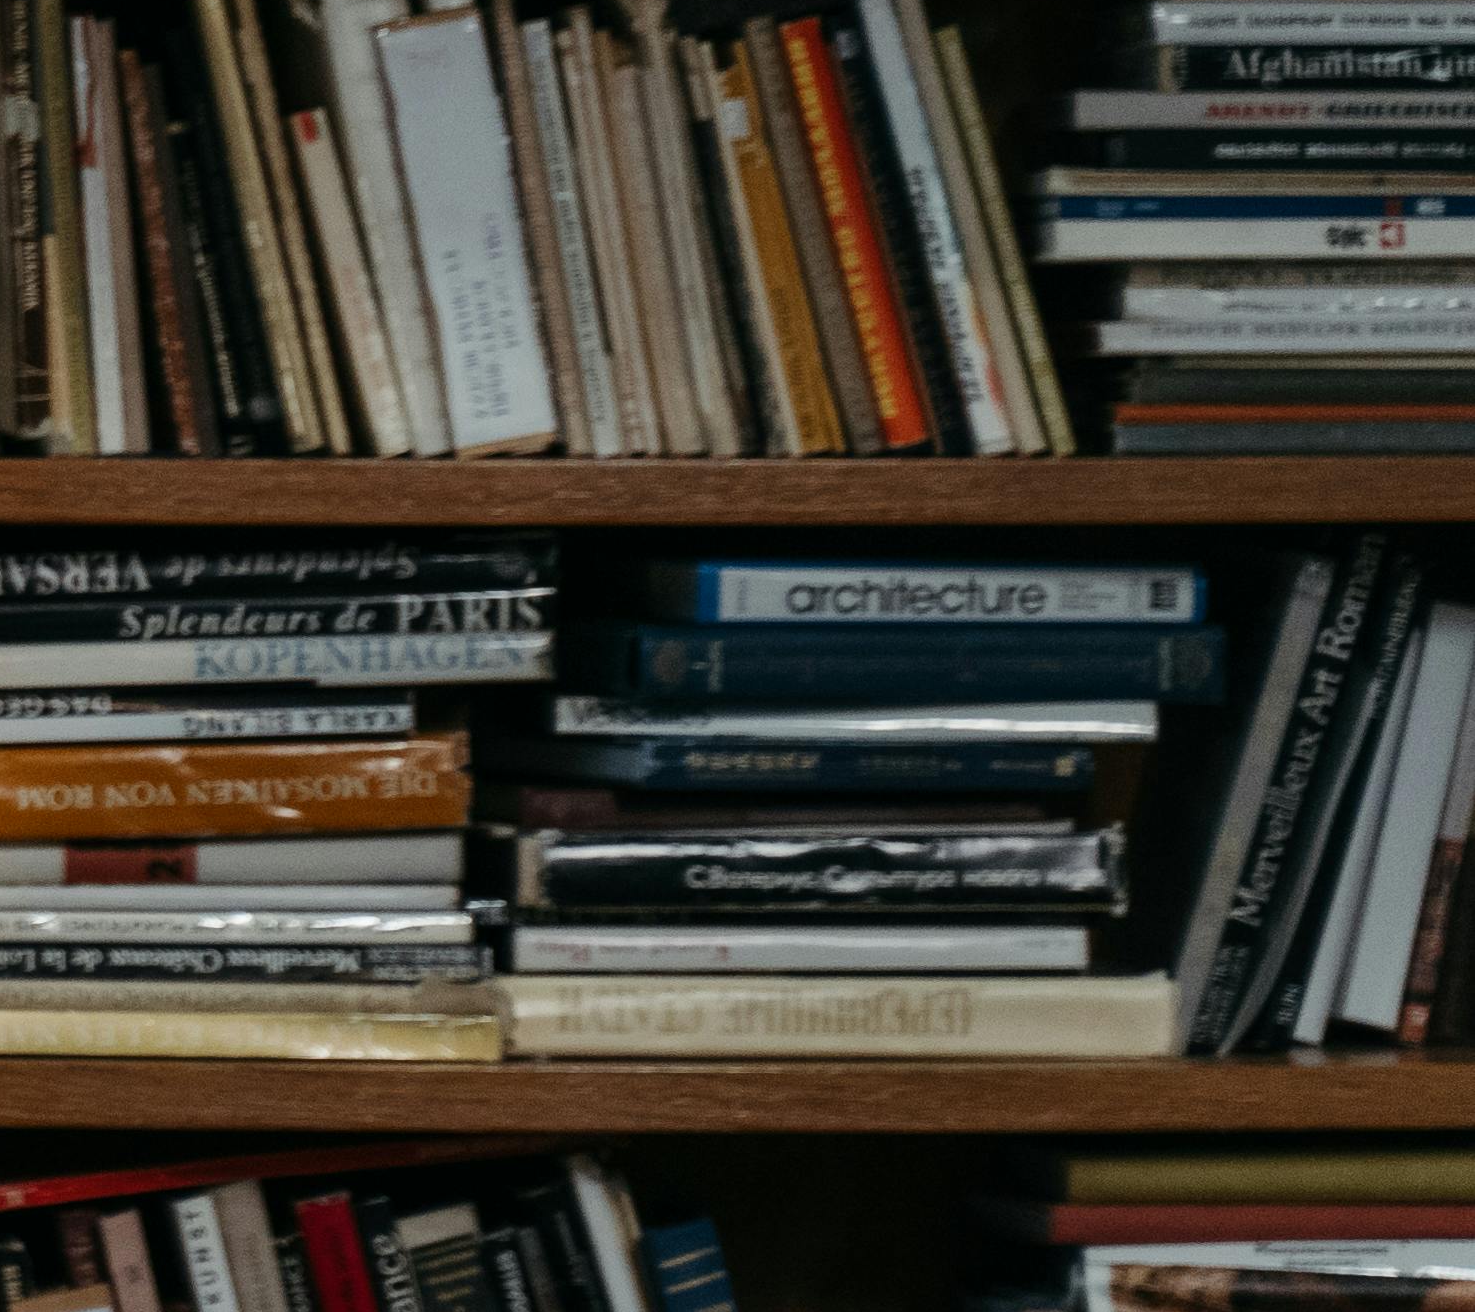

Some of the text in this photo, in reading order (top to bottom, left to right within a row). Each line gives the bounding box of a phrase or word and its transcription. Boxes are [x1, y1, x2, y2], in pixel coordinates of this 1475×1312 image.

[167, 555, 212, 585] de
[219, 546, 417, 580] Splendeurs
[118, 594, 543, 640] Splendeurs de PARIS
[785, 578, 1048, 617] architecture
[194, 635, 527, 679] KOPENHAGEN
[1298, 669, 1342, 727] Art
[12, 770, 436, 811] DIE MOSAIKEN VON ROM
